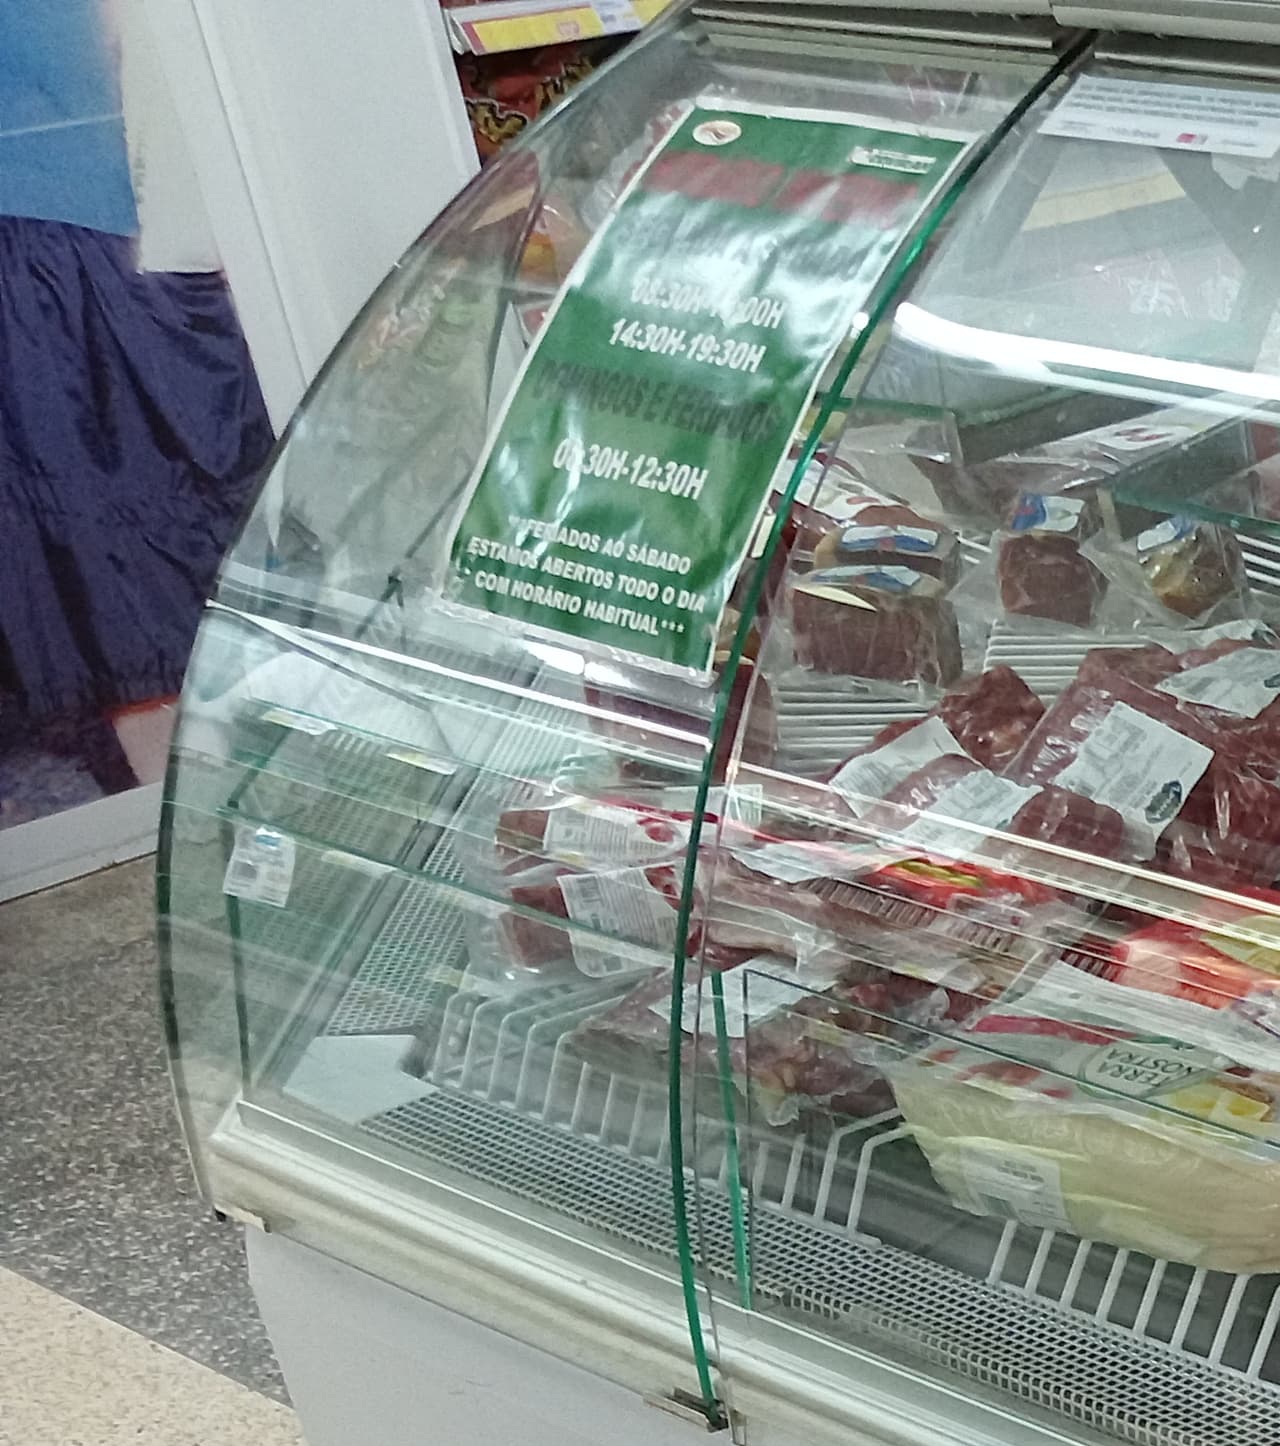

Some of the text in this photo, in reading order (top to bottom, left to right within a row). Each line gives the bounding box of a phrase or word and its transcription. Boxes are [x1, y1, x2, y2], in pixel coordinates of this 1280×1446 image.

[608, 317, 767, 373] 14:30H-19:30H
[626, 541, 692, 576] SÁBADO
[474, 570, 510, 594] COM
[510, 577, 582, 615] HORÁRIO
[541, 555, 615, 591] ABERTOS
[616, 572, 660, 602] TODO
[661, 586, 675, 606] O
[676, 589, 707, 614] DIA
[1097, 1061, 1171, 1087] TERRA
[1106, 1047, 1194, 1078] NOSTRA
